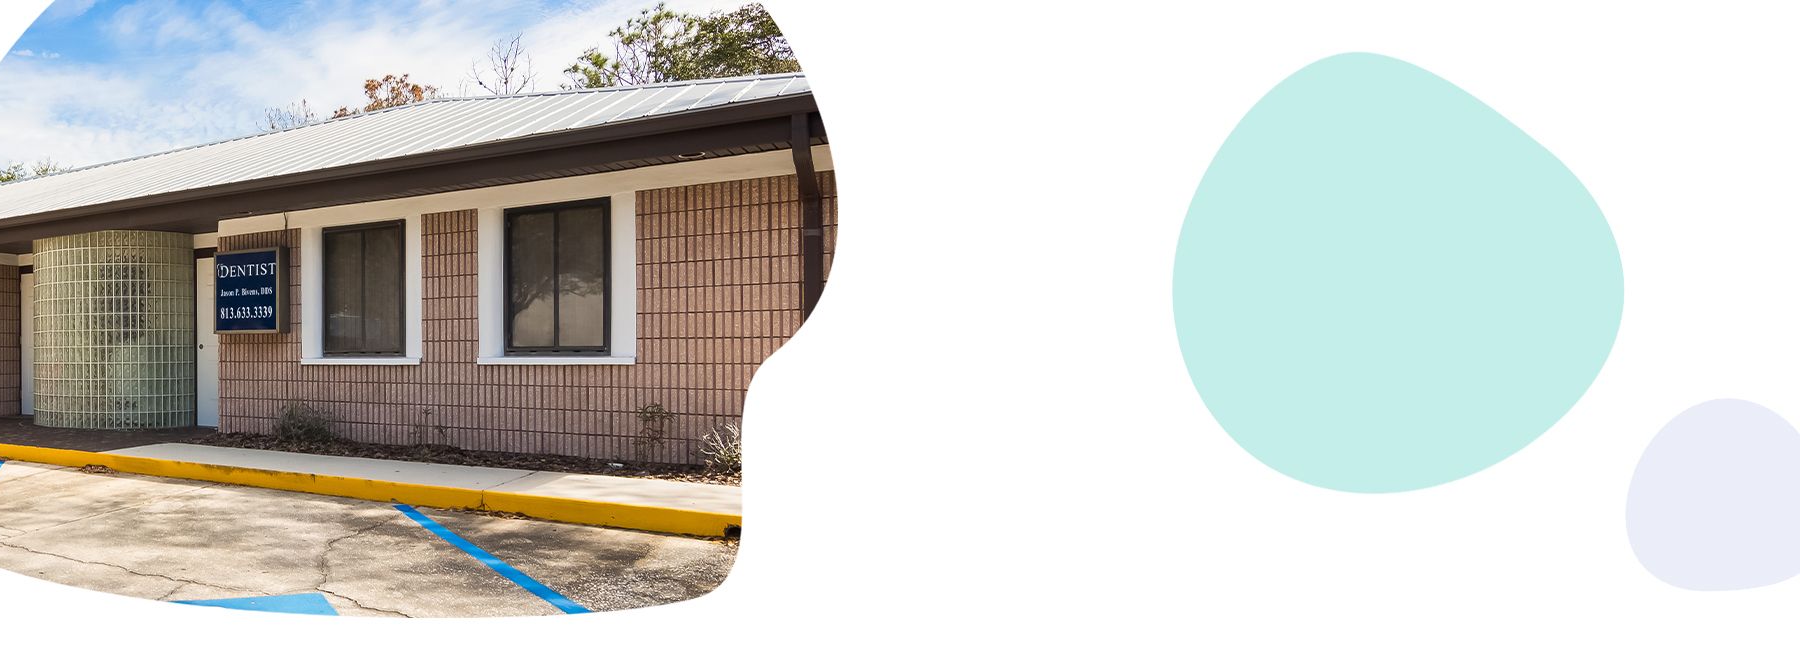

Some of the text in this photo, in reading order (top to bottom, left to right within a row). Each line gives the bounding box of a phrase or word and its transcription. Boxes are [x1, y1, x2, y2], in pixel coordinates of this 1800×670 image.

[220, 263, 276, 278] DENTIST
[220, 289, 234, 297] Jason
[235, 288, 239, 296] P.
[261, 287, 272, 295] DDS
[220, 306, 273, 319] 813.633.3339
